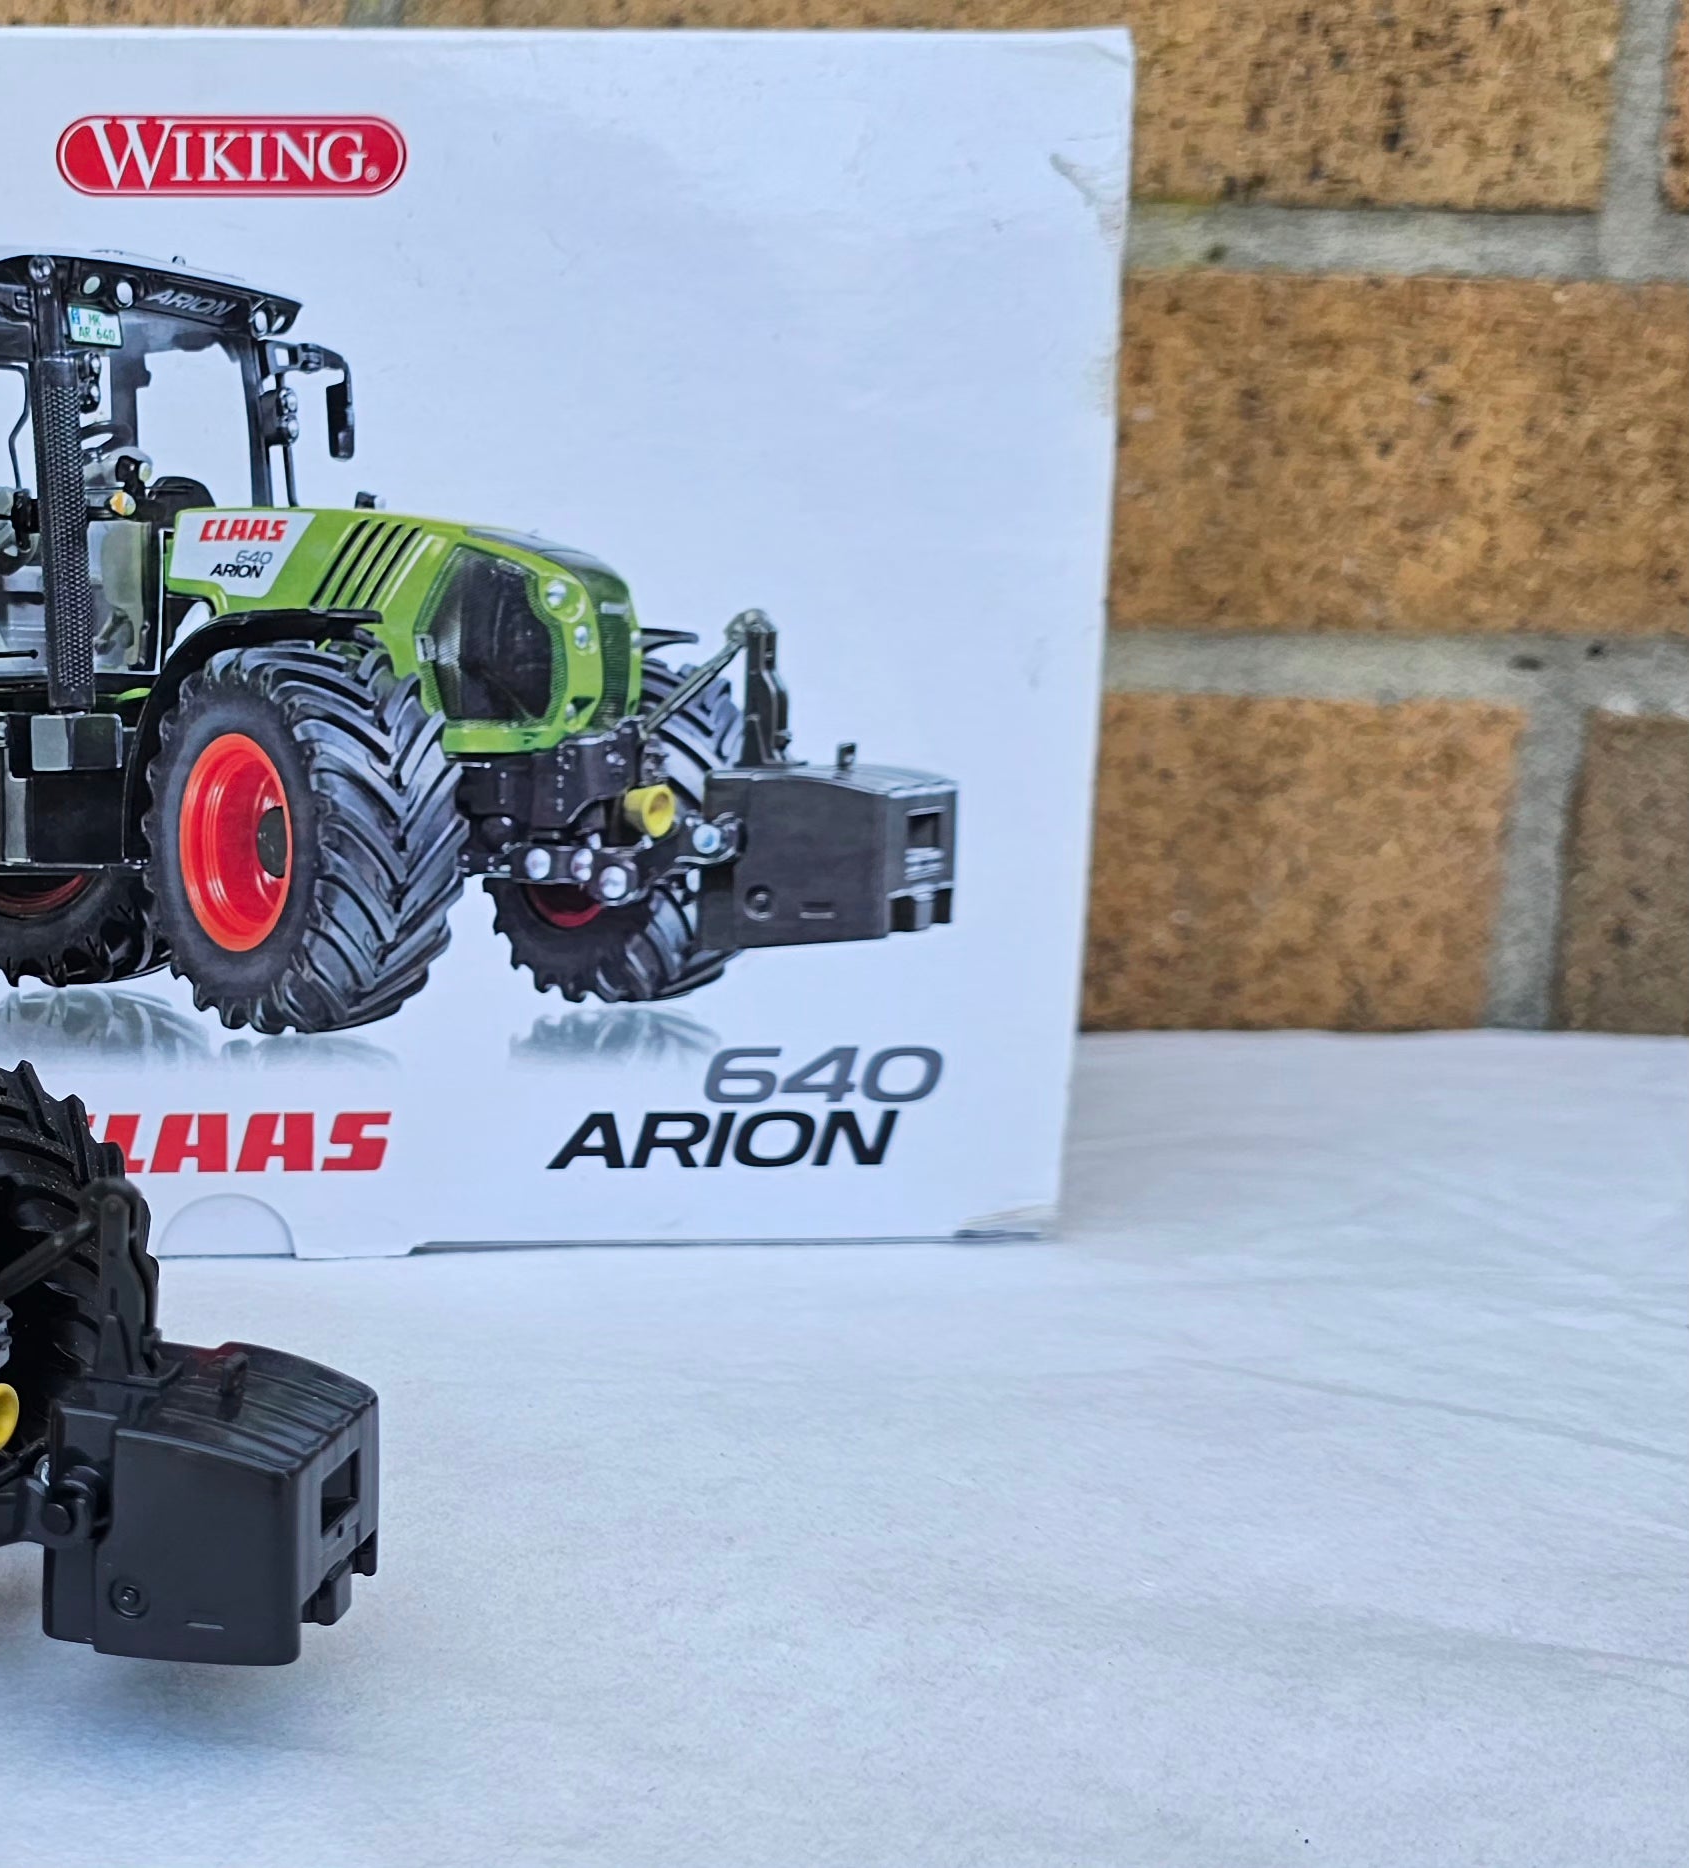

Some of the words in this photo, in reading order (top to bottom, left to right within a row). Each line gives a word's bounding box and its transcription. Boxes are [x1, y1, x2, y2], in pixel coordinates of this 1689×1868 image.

[146, 290, 237, 317] ARION
[199, 519, 288, 542] CLAAS
[210, 564, 264, 578] ARION
[235, 550, 273, 565] 640
[703, 1045, 944, 1104] 640
[87, 1111, 392, 1173] LAAS
[545, 1109, 901, 1169] ARION
